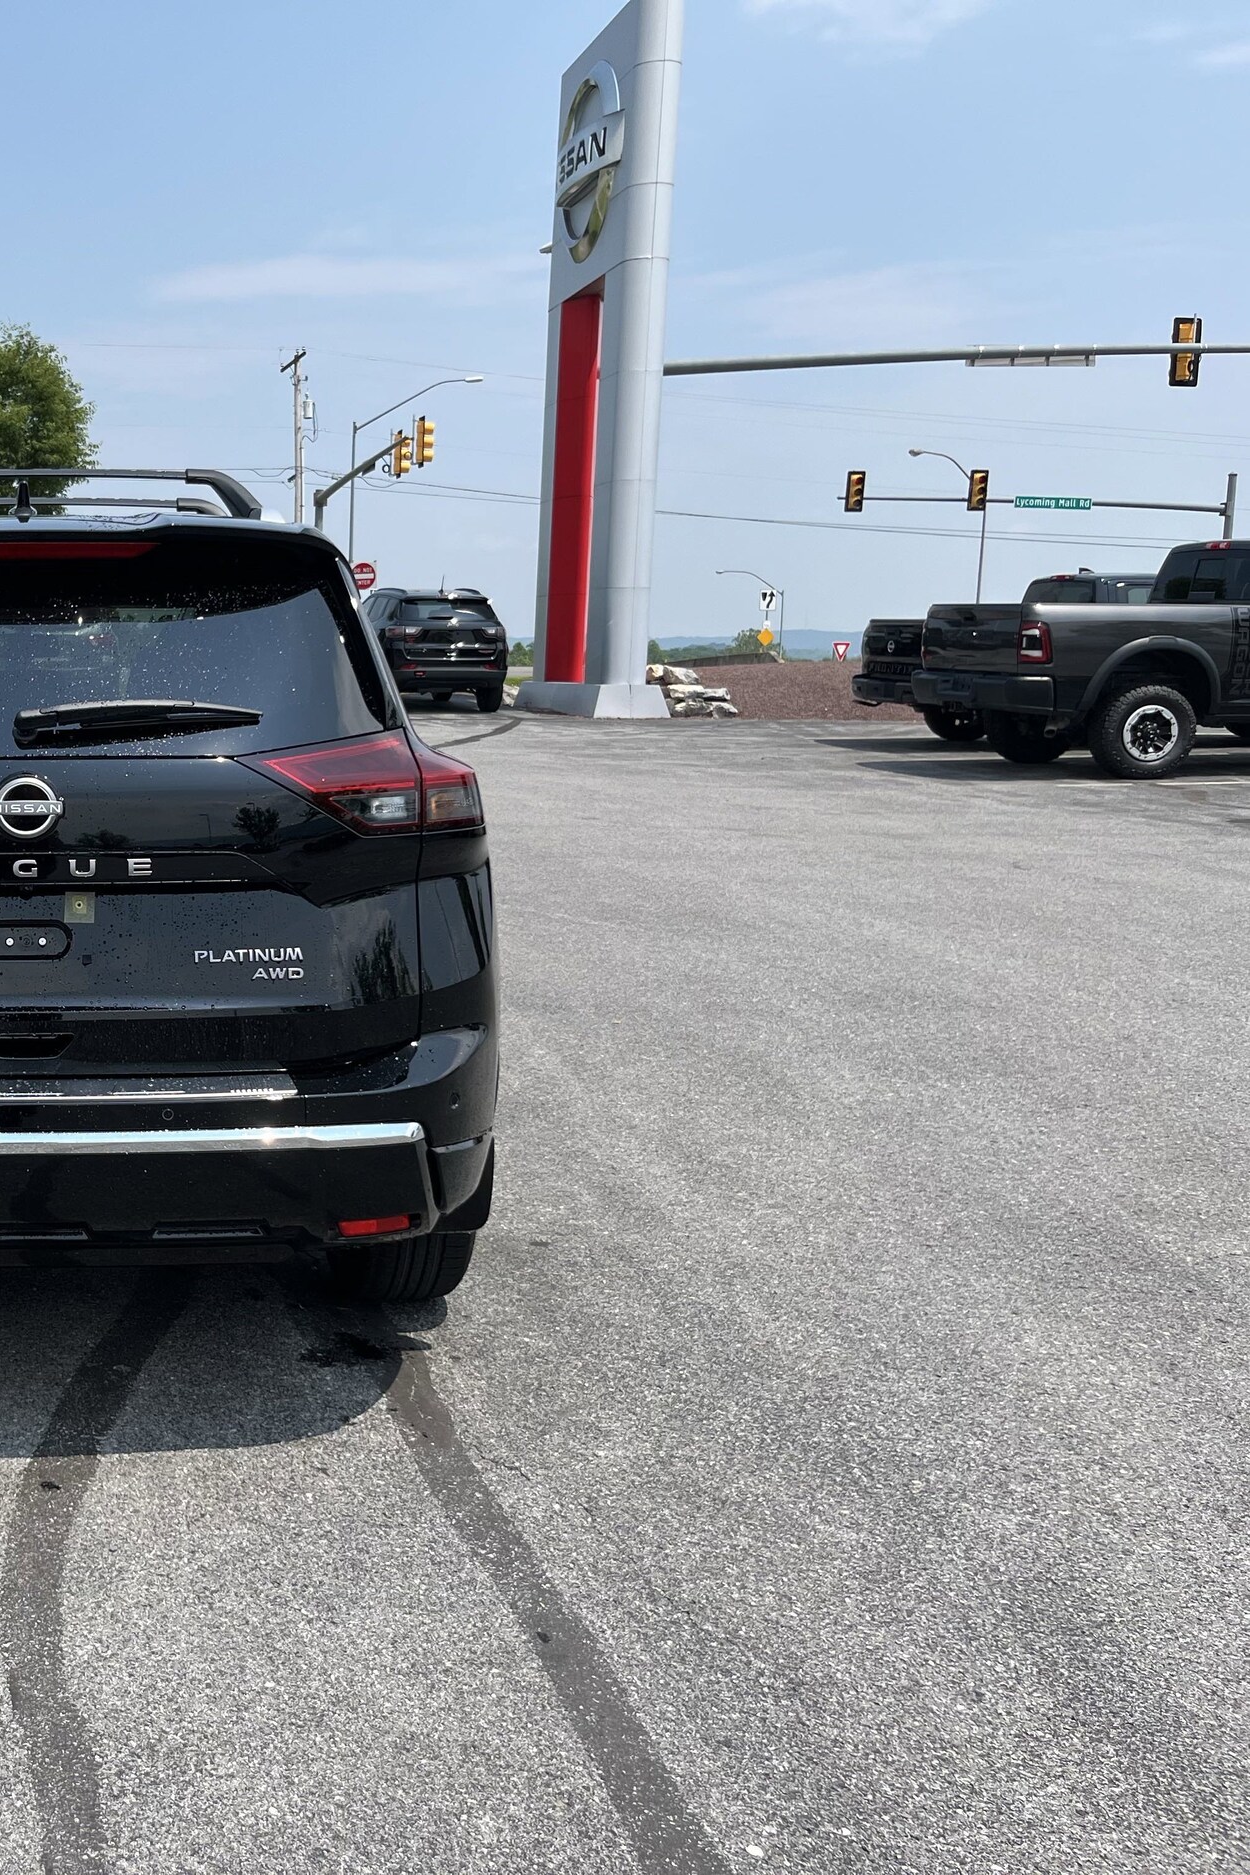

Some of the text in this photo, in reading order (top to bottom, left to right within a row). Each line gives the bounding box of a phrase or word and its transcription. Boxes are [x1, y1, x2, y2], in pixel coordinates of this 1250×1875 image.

[559, 126, 607, 185] SSAN
[1016, 497, 1090, 509] Lycoming Mall Rd
[194, 947, 304, 963] PLATINUM
[252, 967, 305, 980] AWD
